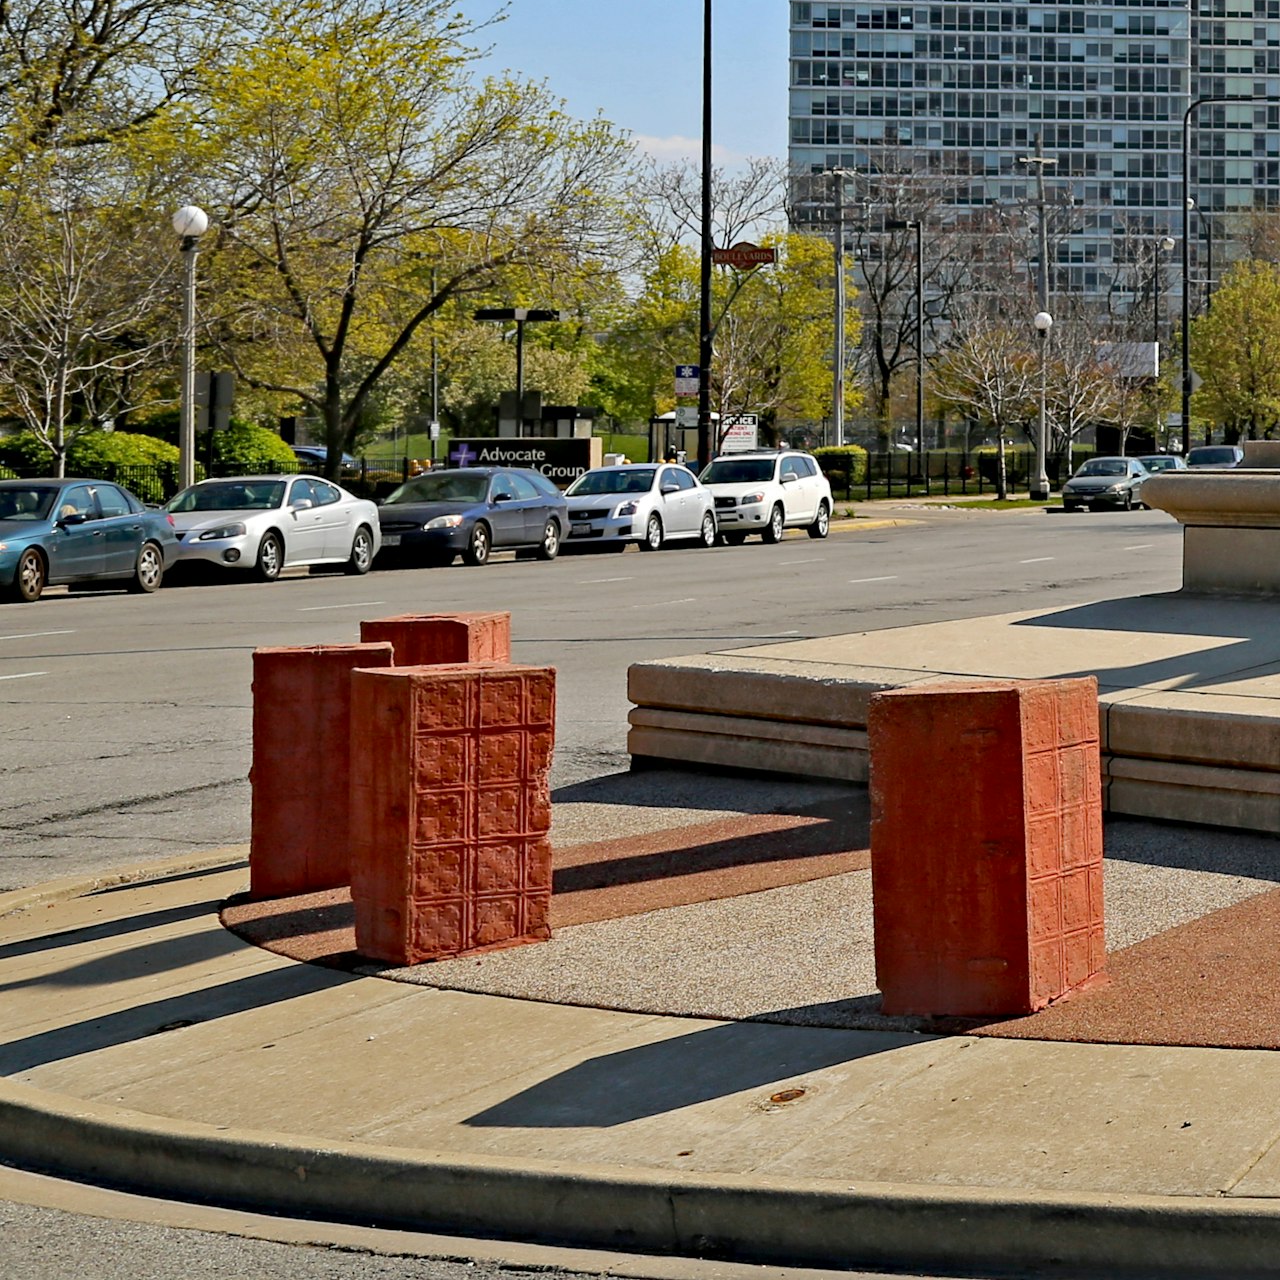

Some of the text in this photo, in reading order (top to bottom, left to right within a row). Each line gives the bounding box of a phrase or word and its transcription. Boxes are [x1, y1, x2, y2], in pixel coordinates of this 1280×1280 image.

[714, 252, 772, 260] BOULEVARDS
[479, 447, 546, 461] Advocate
[540, 463, 585, 479] Group
